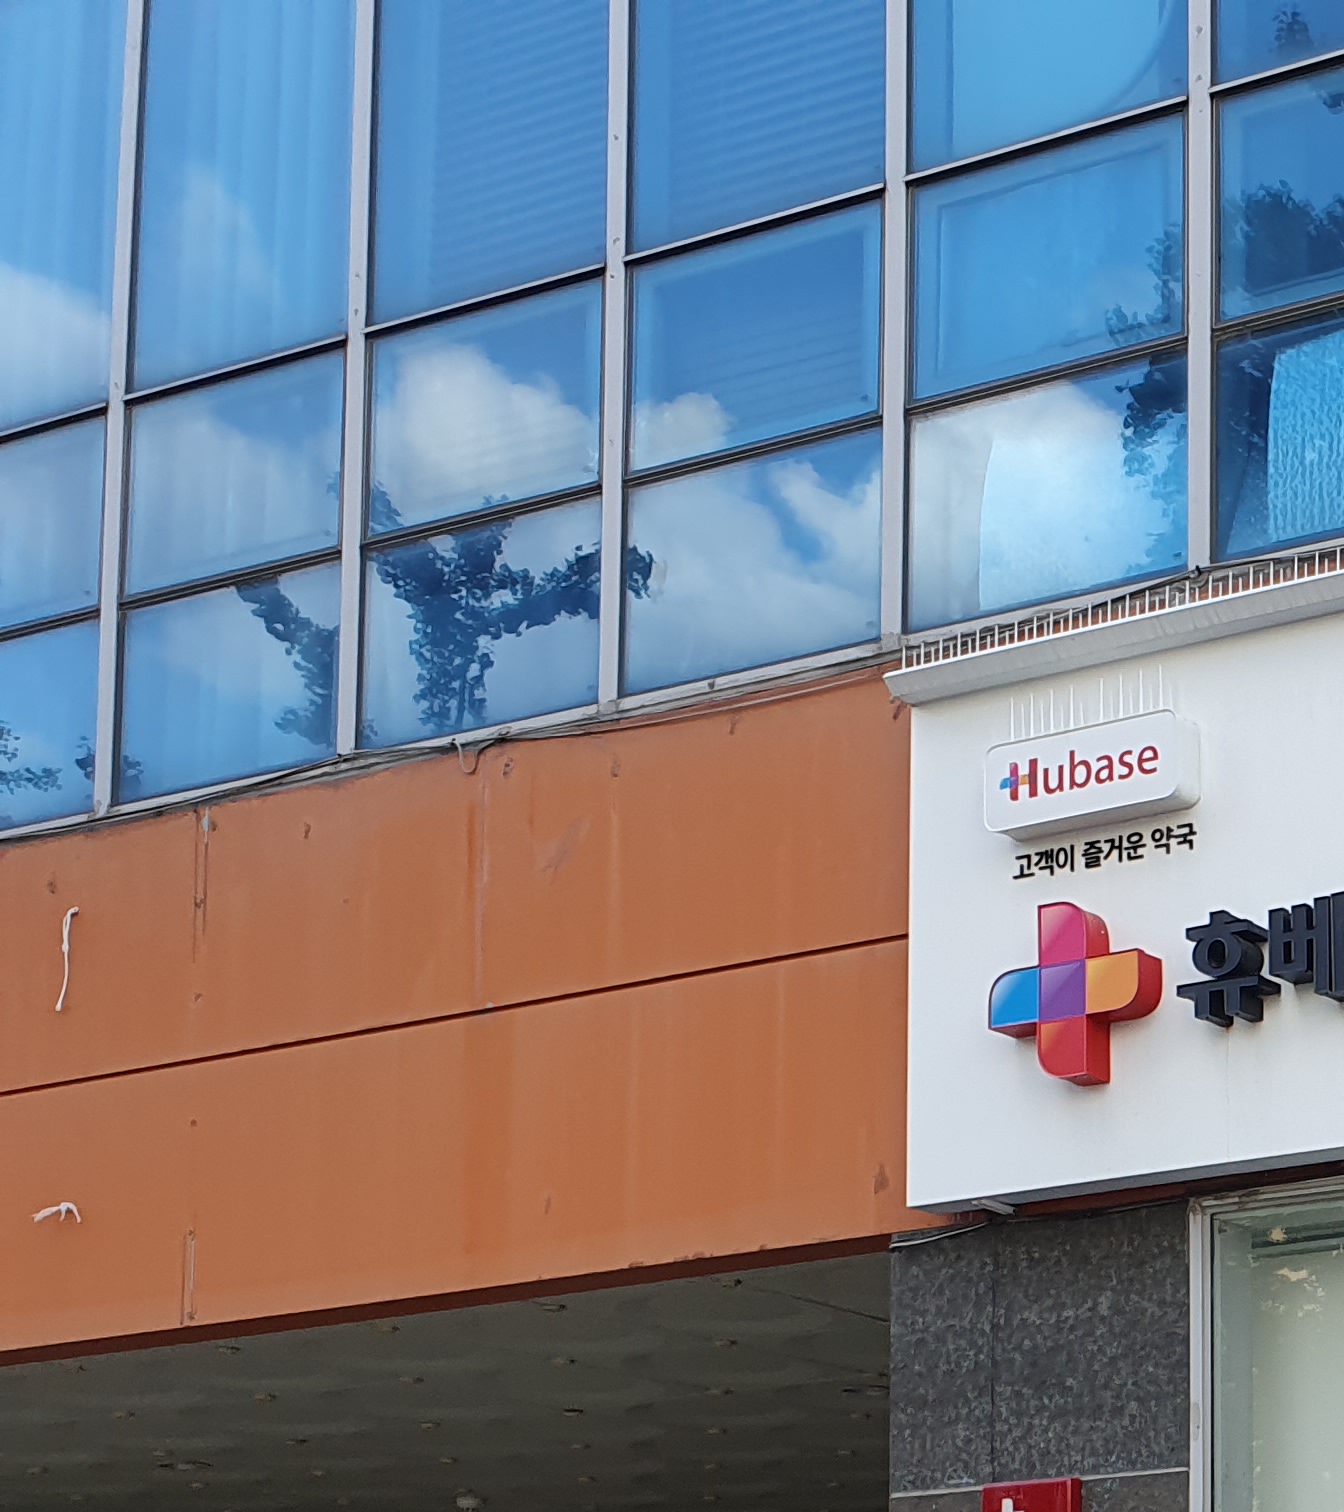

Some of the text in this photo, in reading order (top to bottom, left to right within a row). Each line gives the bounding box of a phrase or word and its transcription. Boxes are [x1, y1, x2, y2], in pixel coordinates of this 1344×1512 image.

[1000, 744, 1161, 802] Hubase
[1011, 822, 1198, 881] 고객이 즐거운 약국
